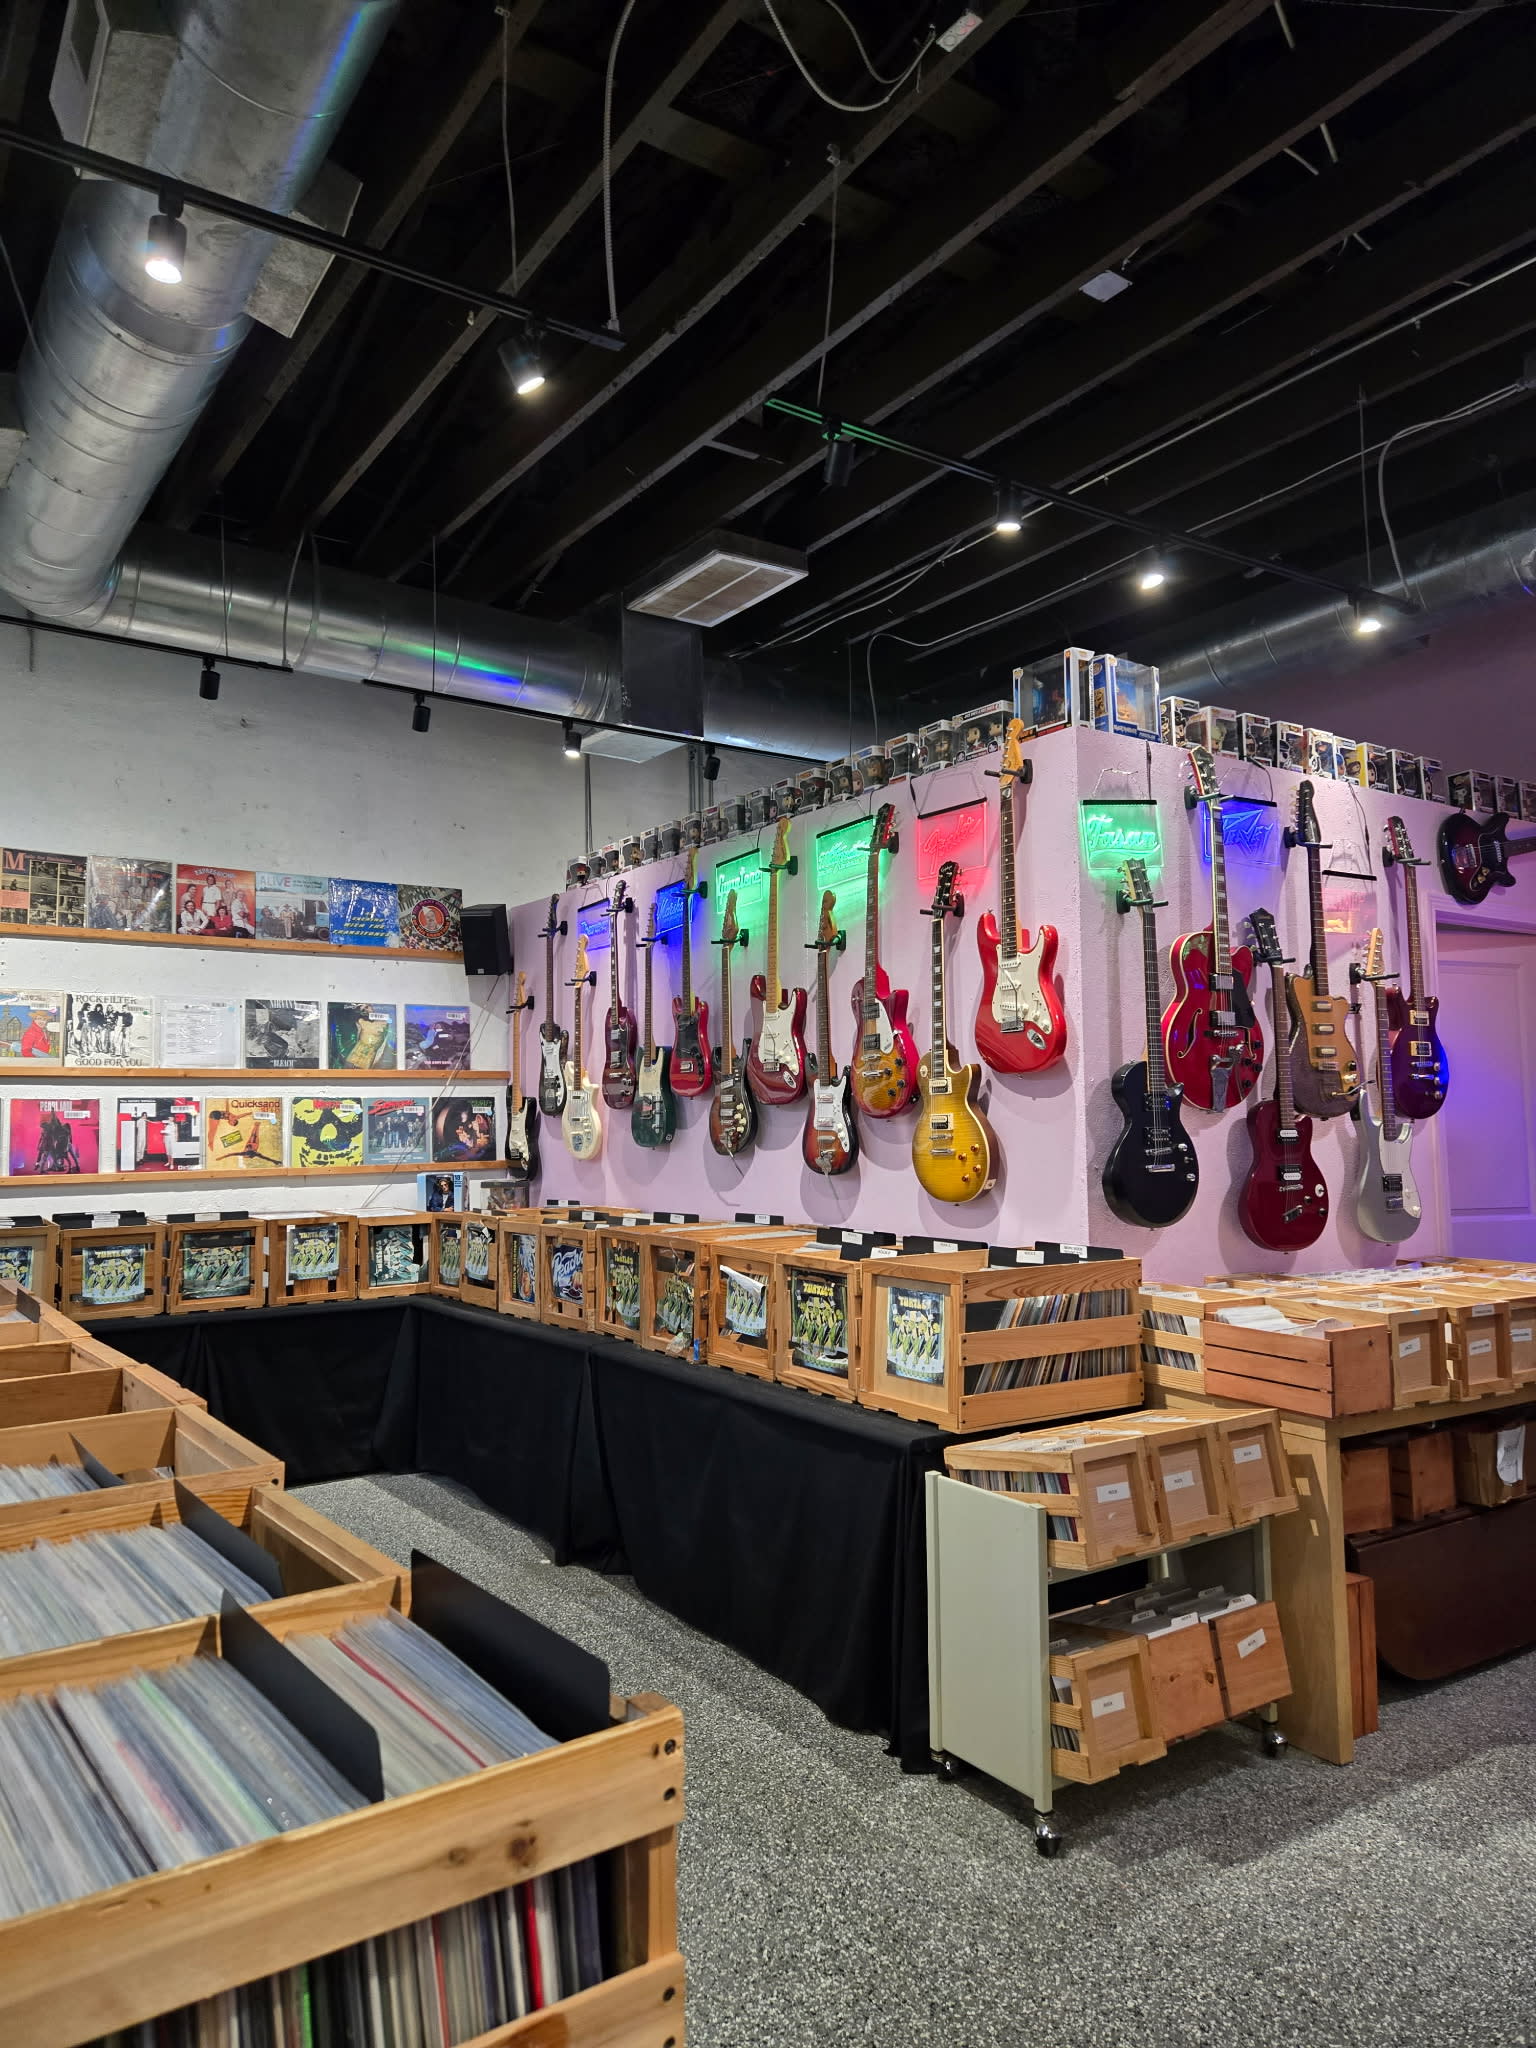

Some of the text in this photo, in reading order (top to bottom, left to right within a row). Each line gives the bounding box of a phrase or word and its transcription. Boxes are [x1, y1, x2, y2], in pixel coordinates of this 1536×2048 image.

[76, 994, 137, 1004] ROCKFILTER
[75, 1059, 102, 1067] GOOD
[103, 1059, 123, 1067] FOR
[231, 1100, 281, 1108] Quicksand
